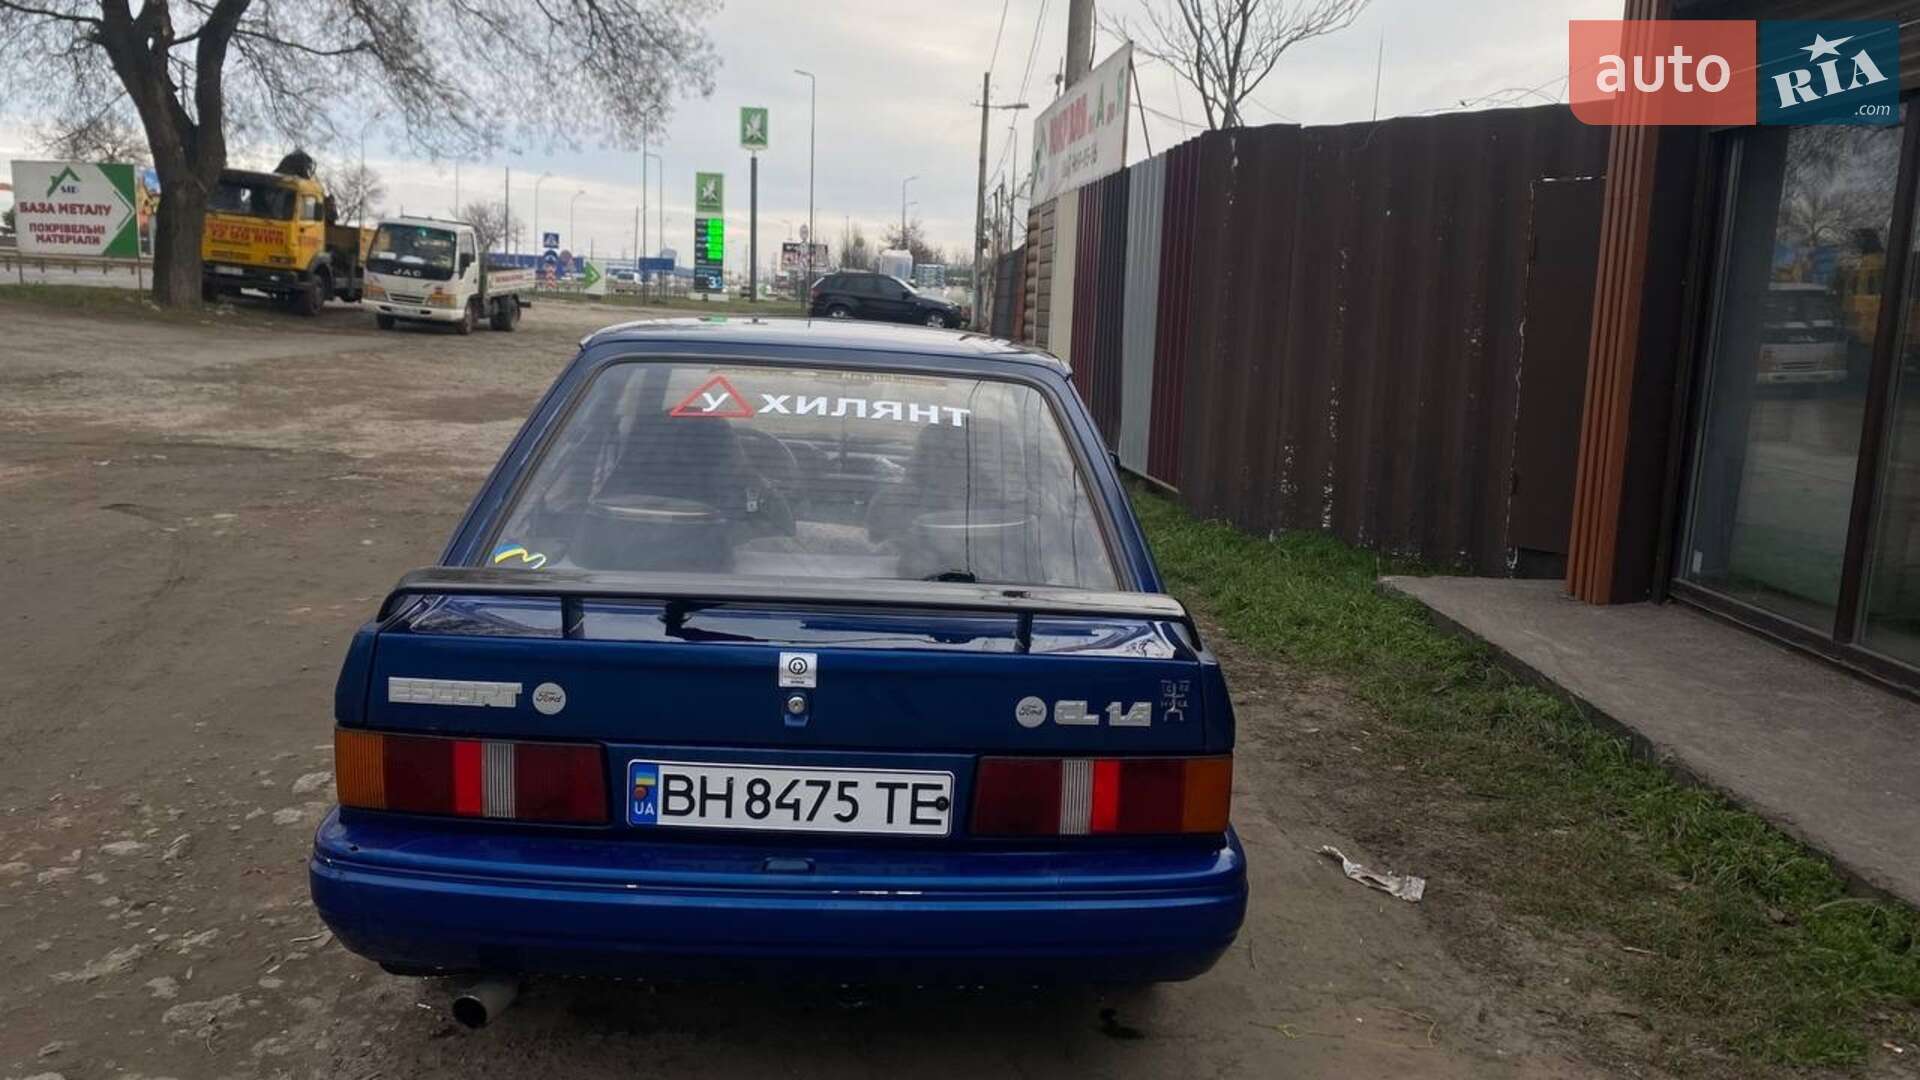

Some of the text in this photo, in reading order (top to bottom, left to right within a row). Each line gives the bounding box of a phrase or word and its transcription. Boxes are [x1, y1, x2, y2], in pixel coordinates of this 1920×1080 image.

[19, 202, 112, 216] БАЗА МЕТАЛУ
[393, 268, 422, 277] JAC
[702, 392, 971, 427] У ХИЛЯНТ
[388, 676, 523, 708] ESCORT
[535, 691, 562, 704] Ford
[661, 773, 944, 826] BH 8475 TE
[634, 801, 655, 816] UA
